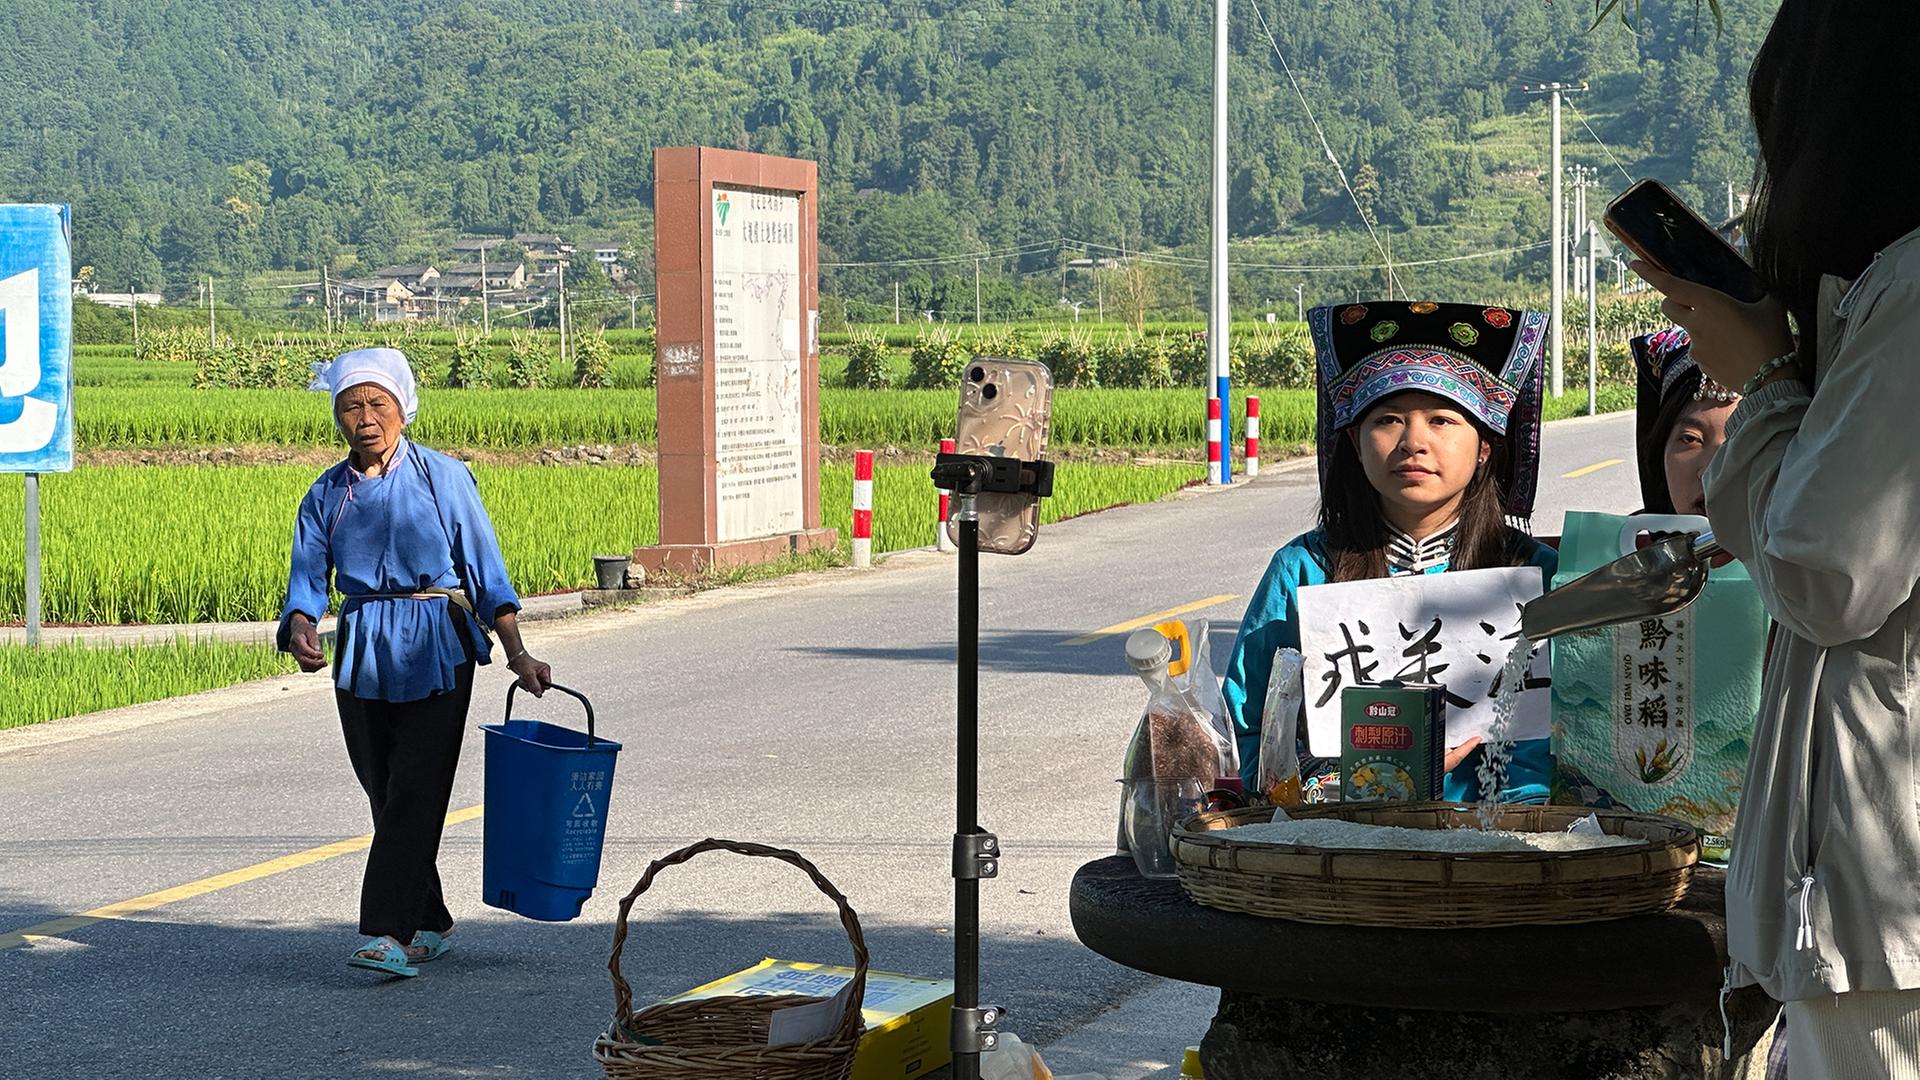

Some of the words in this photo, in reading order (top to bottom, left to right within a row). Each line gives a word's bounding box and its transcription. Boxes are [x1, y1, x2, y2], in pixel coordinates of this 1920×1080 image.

[1623, 654, 1632, 679] QIAN
[1638, 617, 1673, 729] 黔味稻
[1624, 683, 1632, 702] WEI
[1624, 704, 1632, 725] DAO
[1354, 726, 1408, 745] 刺梨原汁
